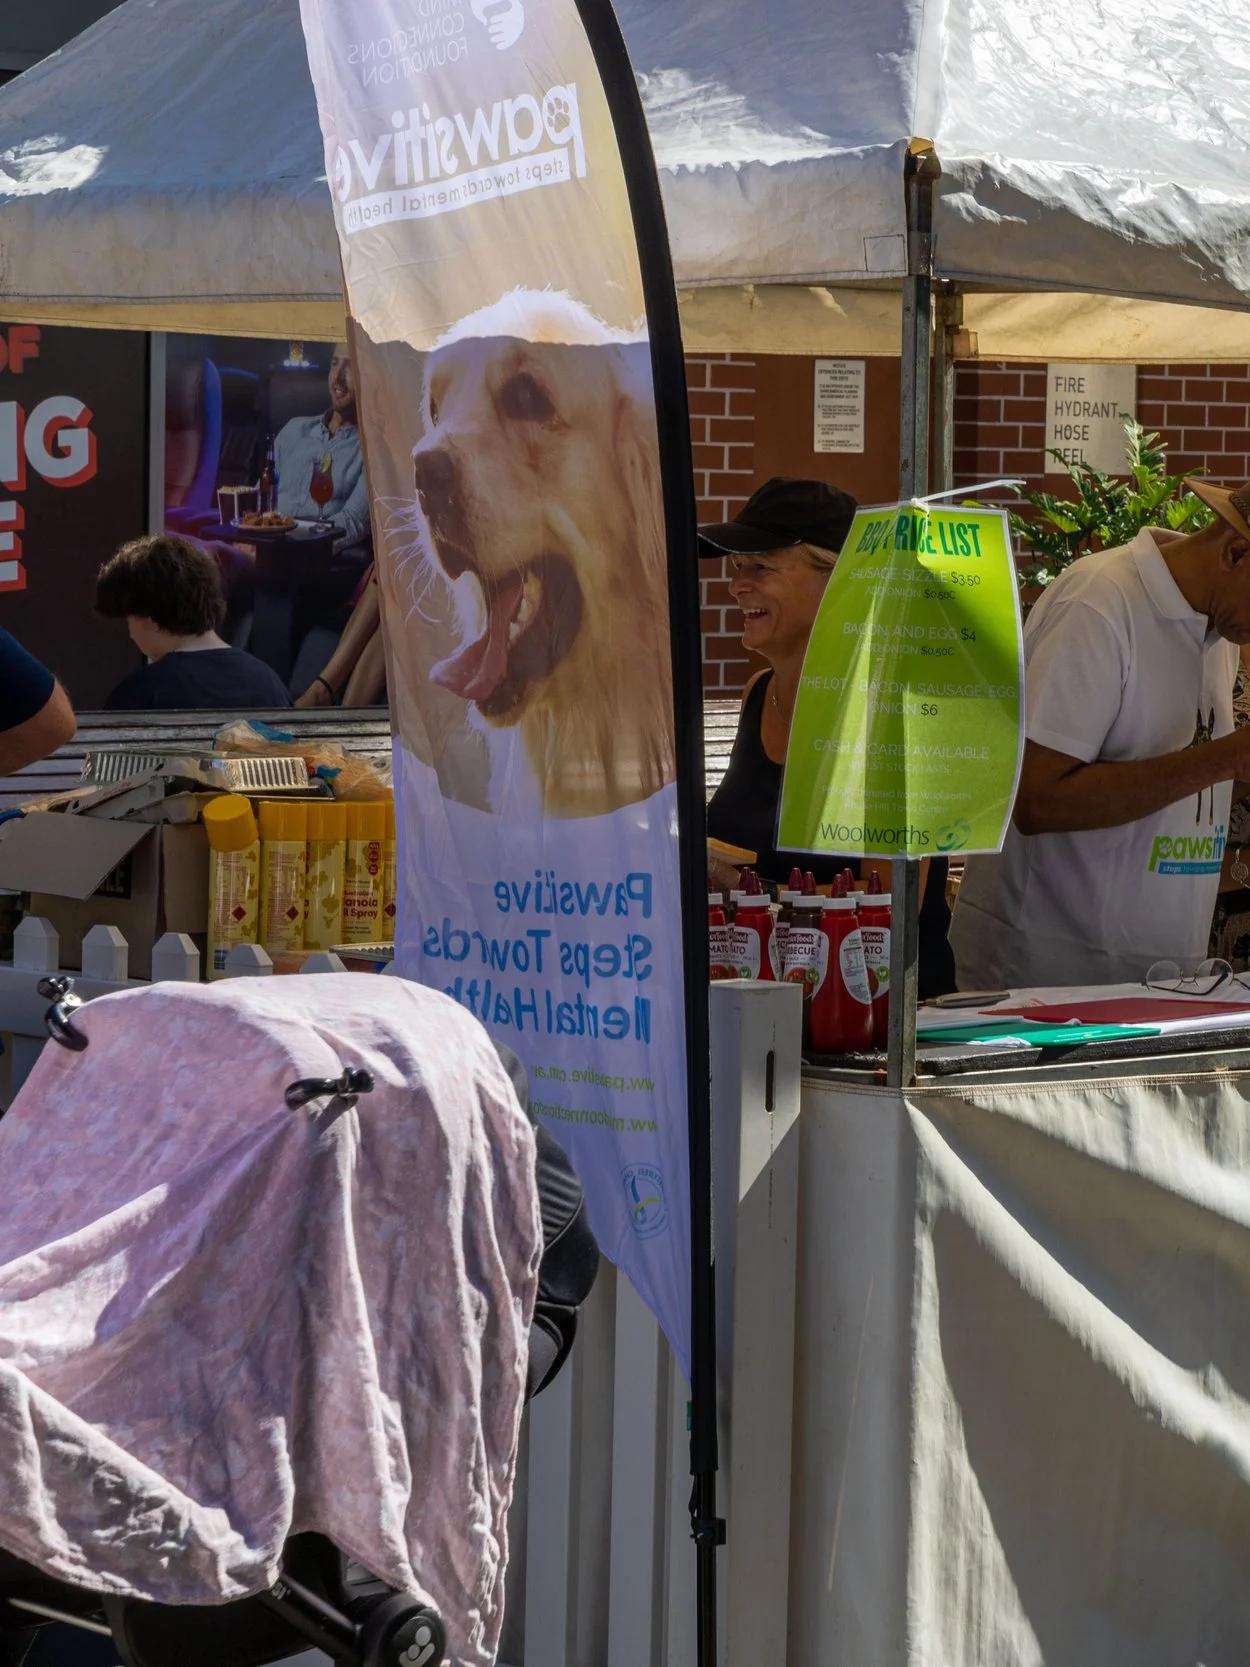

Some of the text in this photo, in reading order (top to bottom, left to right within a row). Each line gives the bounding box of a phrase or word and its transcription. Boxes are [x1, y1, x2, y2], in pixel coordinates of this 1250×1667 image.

[1055, 376, 1085, 393] FIRE
[1054, 400, 1119, 419] HYDRANT
[1053, 424, 1090, 441] HOSE
[856, 519, 890, 556] BBQ
[938, 521, 981, 557] LIST
[902, 568, 948, 583] SIZZLE
[951, 571, 981, 586] $3.50
[843, 622, 976, 642] BACON AND EGG $4
[801, 676, 820, 689] THE
[823, 677, 847, 690] LOT
[871, 701, 938, 716] ONION $6
[813, 739, 850, 752] CASH
[866, 743, 908, 757] CARD
[912, 744, 989, 759] AVAILABLE
[821, 823, 929, 845] Woolworths
